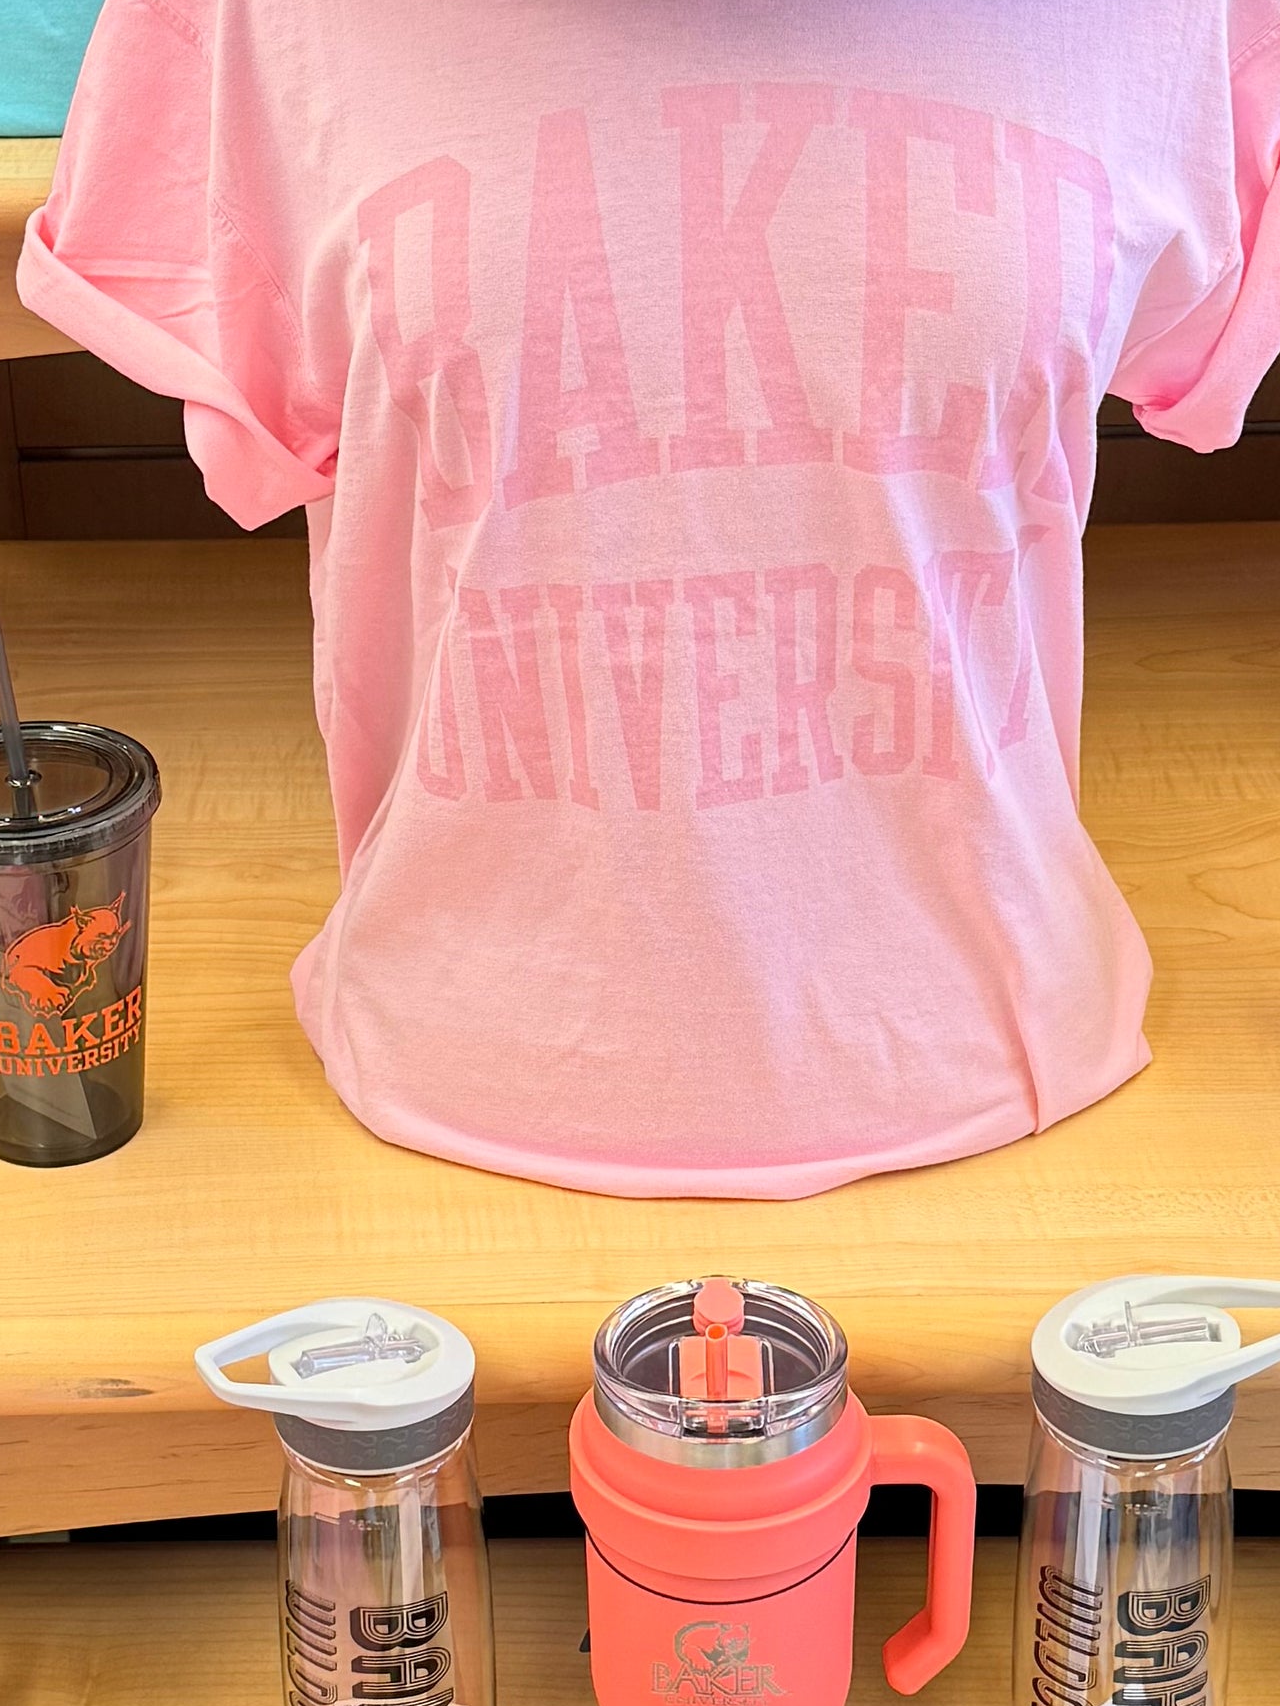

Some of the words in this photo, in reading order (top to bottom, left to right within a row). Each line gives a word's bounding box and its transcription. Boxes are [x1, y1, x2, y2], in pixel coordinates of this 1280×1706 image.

[355, 80, 1118, 534] BAKER
[415, 524, 1053, 813] UNIVERSITY
[651, 1661, 788, 1697] BAKER
